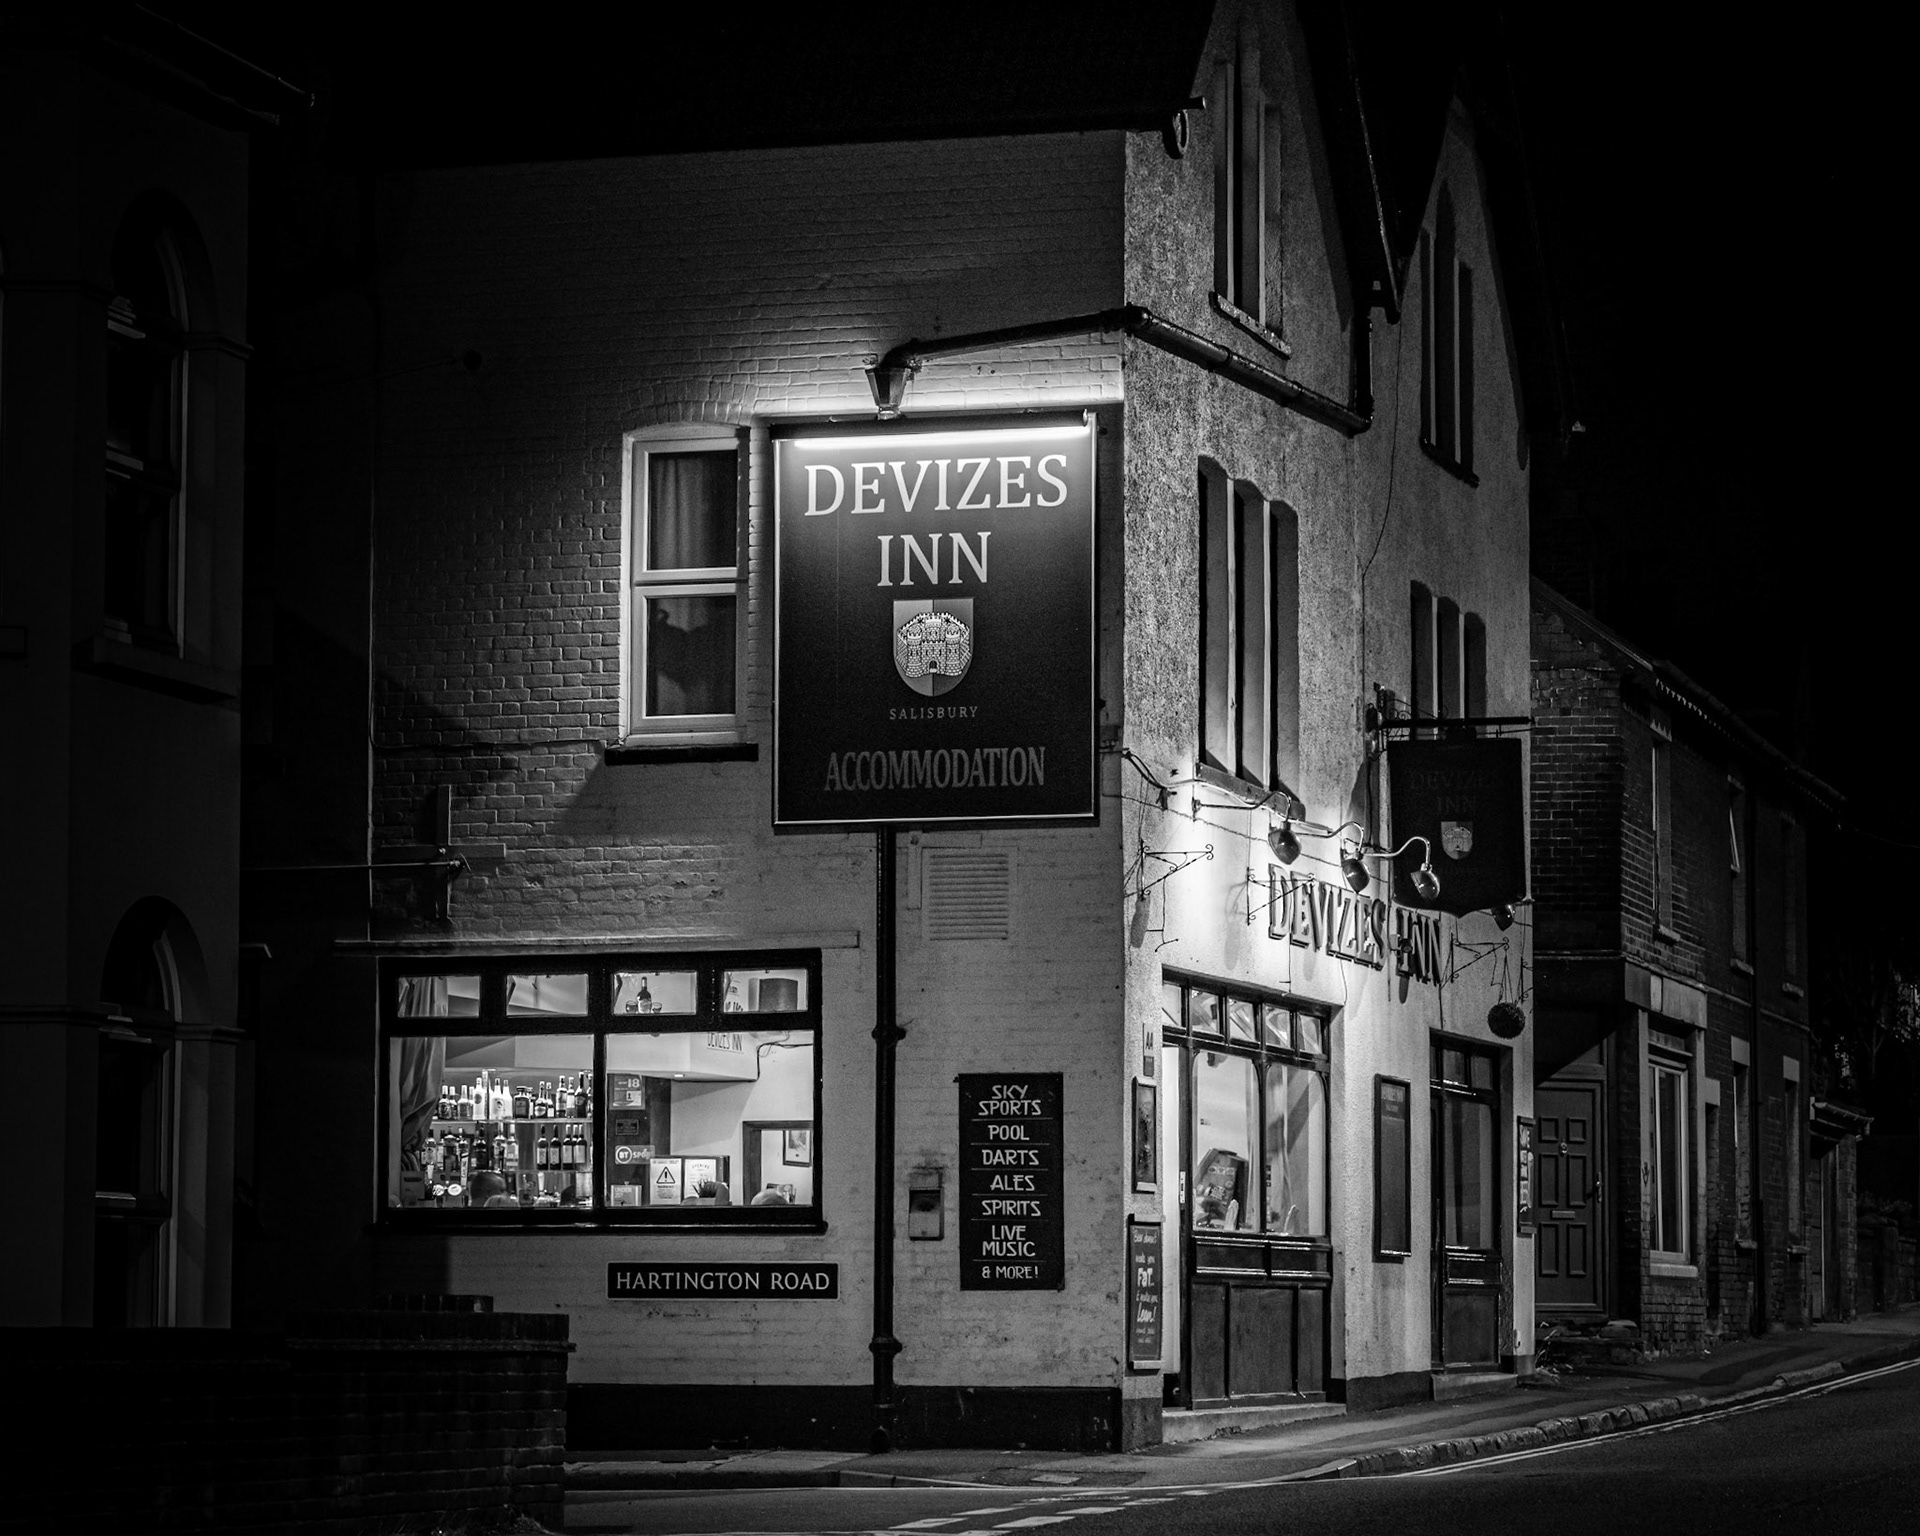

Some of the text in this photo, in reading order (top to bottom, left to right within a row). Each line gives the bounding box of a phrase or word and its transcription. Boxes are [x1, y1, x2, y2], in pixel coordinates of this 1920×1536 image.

[804, 454, 1068, 516] DEVIZES
[877, 531, 991, 587] INN
[889, 706, 978, 720] SALISBURY
[824, 746, 1046, 791] ACCOMMODATION
[1268, 863, 1443, 987] DEVIZES INN
[991, 1085, 1029, 1100] SKY
[978, 1100, 1042, 1116] SPORTS
[988, 1125, 1030, 1141] POOL
[982, 1150, 1040, 1166] DARTS
[990, 1175, 1035, 1192] ALES
[982, 1200, 1041, 1217] SPIRITS
[991, 1225, 1027, 1241] LIVE
[982, 1241, 1036, 1257] MUSIC
[982, 1266, 1039, 1279] & MORE!
[617, 1272, 830, 1290] HARTINGTON ROAD
